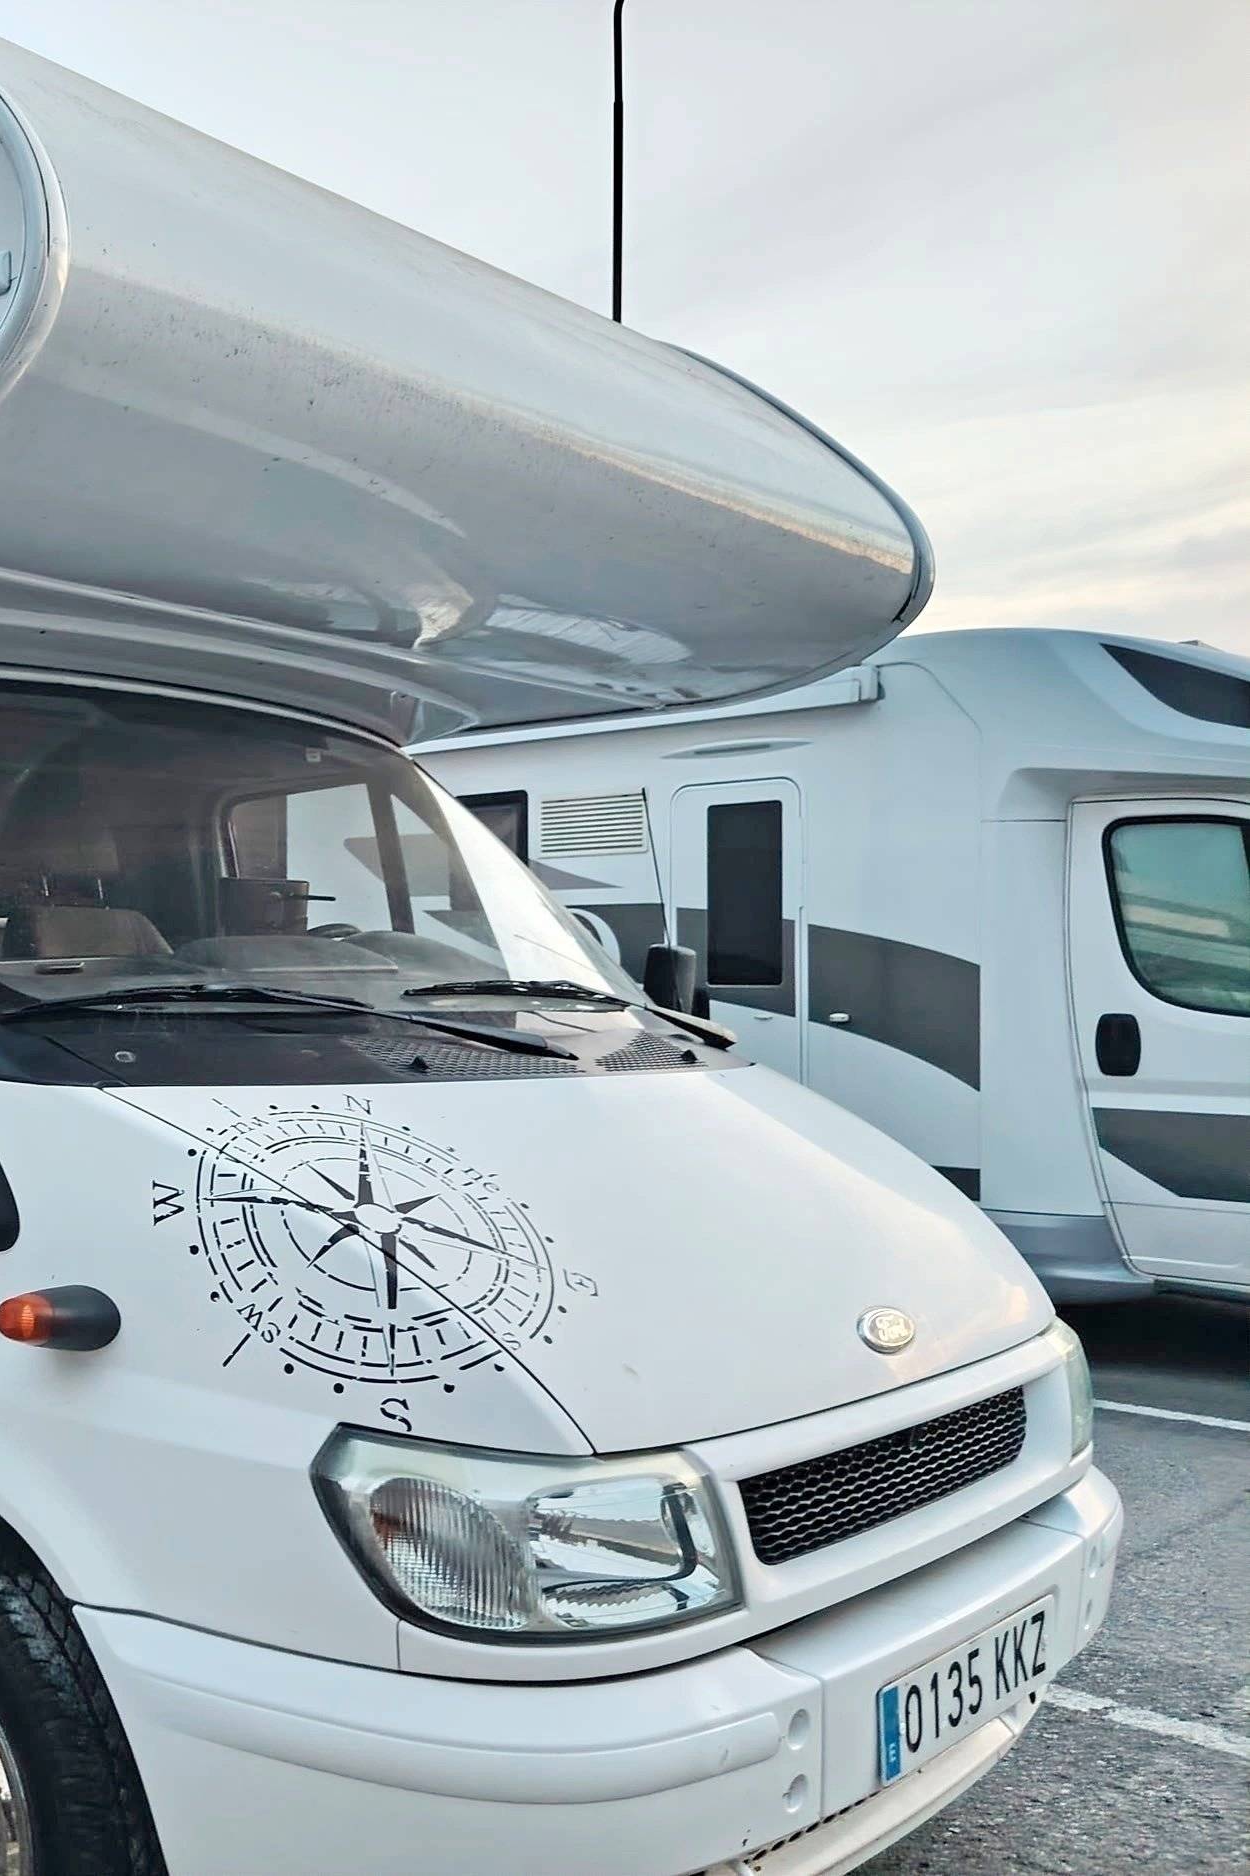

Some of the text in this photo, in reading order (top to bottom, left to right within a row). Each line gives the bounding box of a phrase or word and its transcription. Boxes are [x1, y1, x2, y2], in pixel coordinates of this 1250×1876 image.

[342, 1093, 373, 1115] N
[152, 1180, 185, 1226] W
[380, 1397, 412, 1432] S
[905, 1610, 1046, 1753] 0135 KKZ
